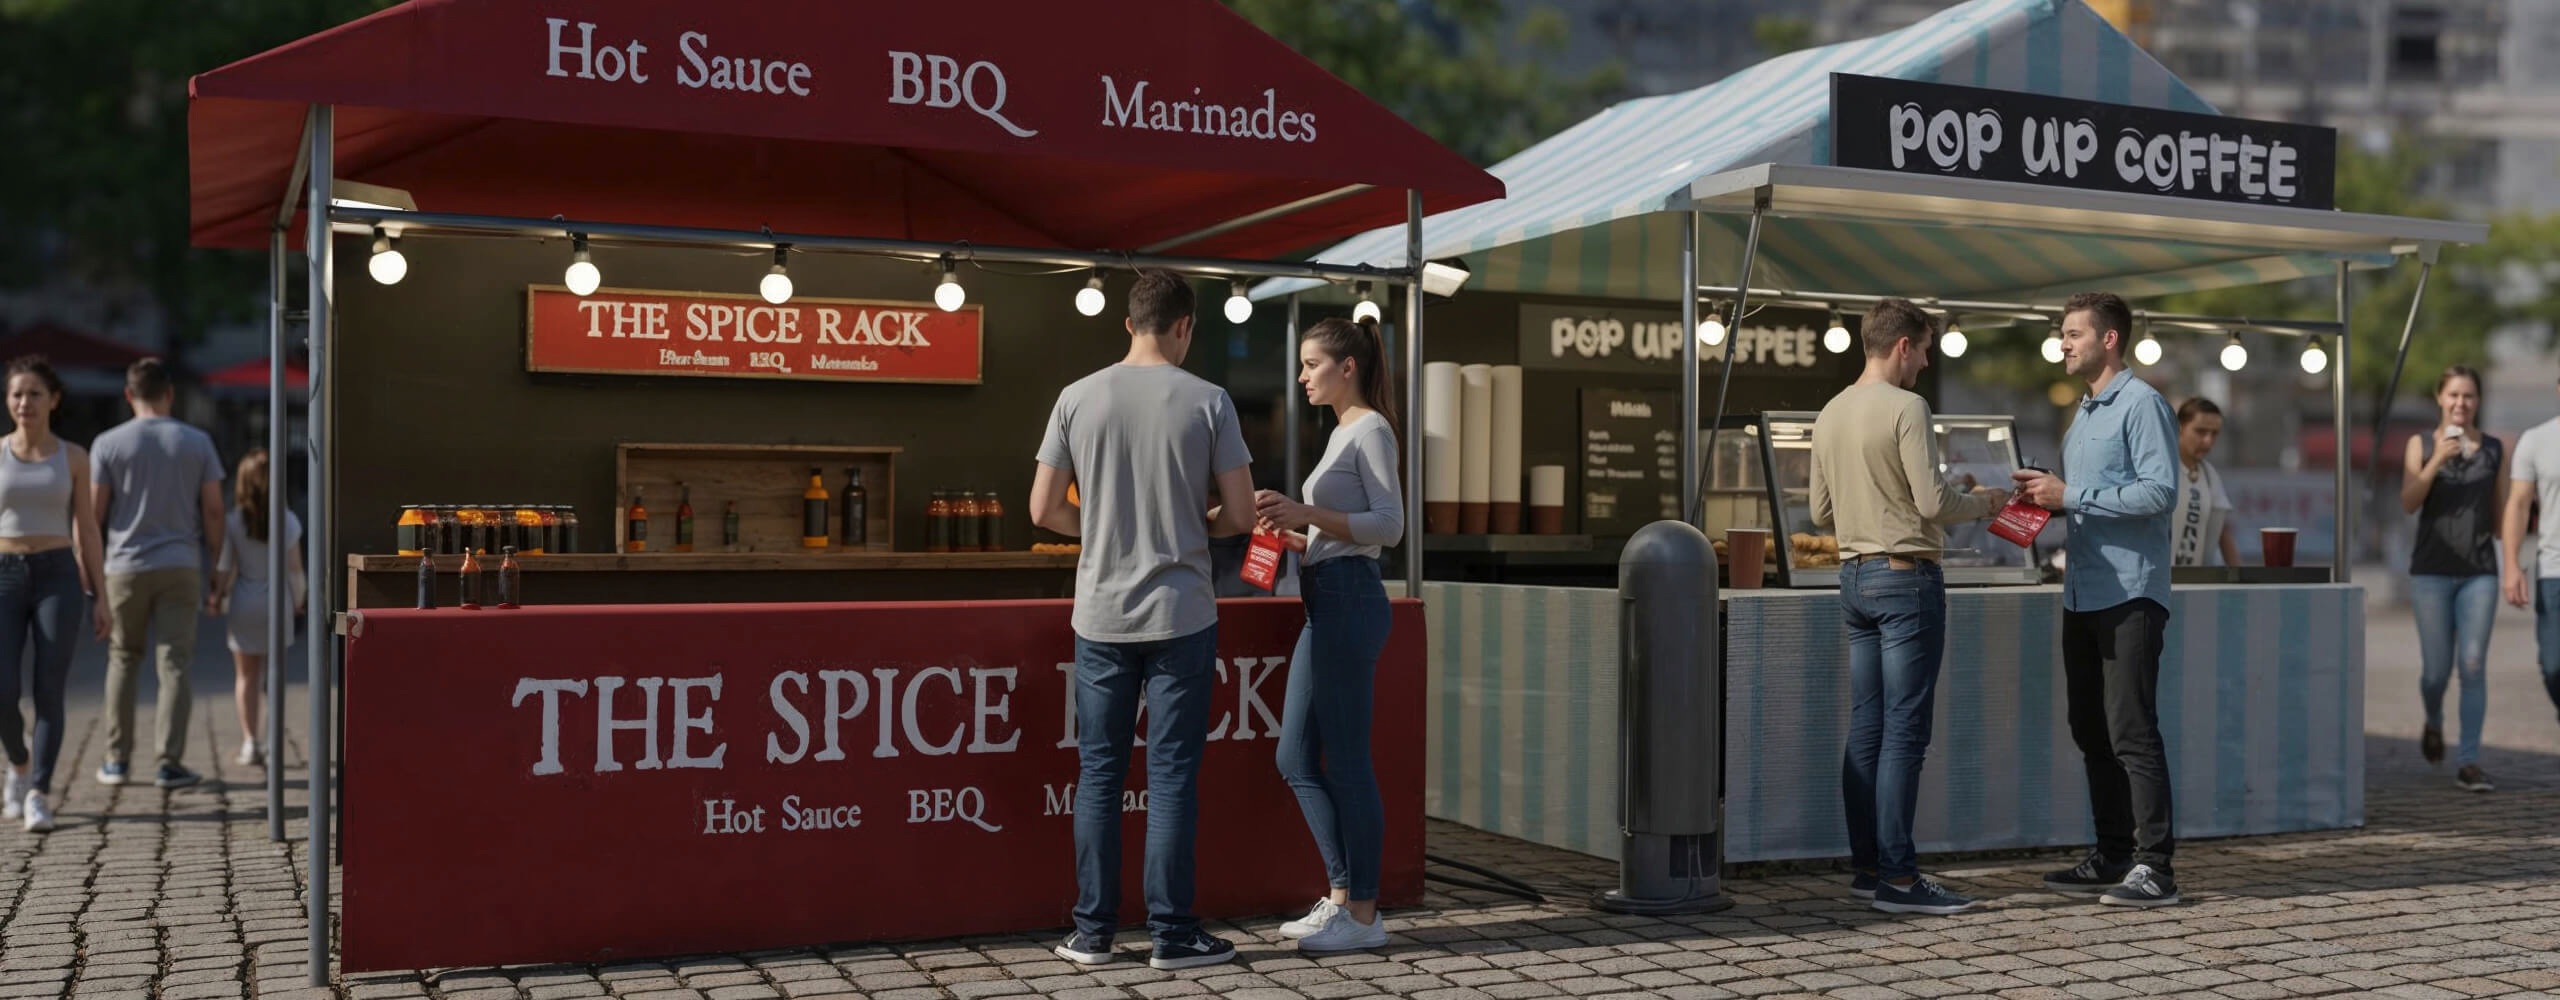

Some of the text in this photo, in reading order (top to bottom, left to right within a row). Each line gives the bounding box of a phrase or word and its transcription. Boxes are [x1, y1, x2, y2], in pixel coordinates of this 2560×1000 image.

[547, 18, 811, 96] Hot Sauce
[889, 51, 1037, 137] BBQ
[1102, 76, 1316, 143] Marinades
[1889, 102, 2297, 201] POP UP COFFEE
[578, 301, 930, 346] THE SPICE RACK
[1551, 317, 1625, 357] POP
[512, 673, 727, 775] THE
[767, 667, 1020, 764] SPICE
[704, 795, 861, 833] Hot Sauce
